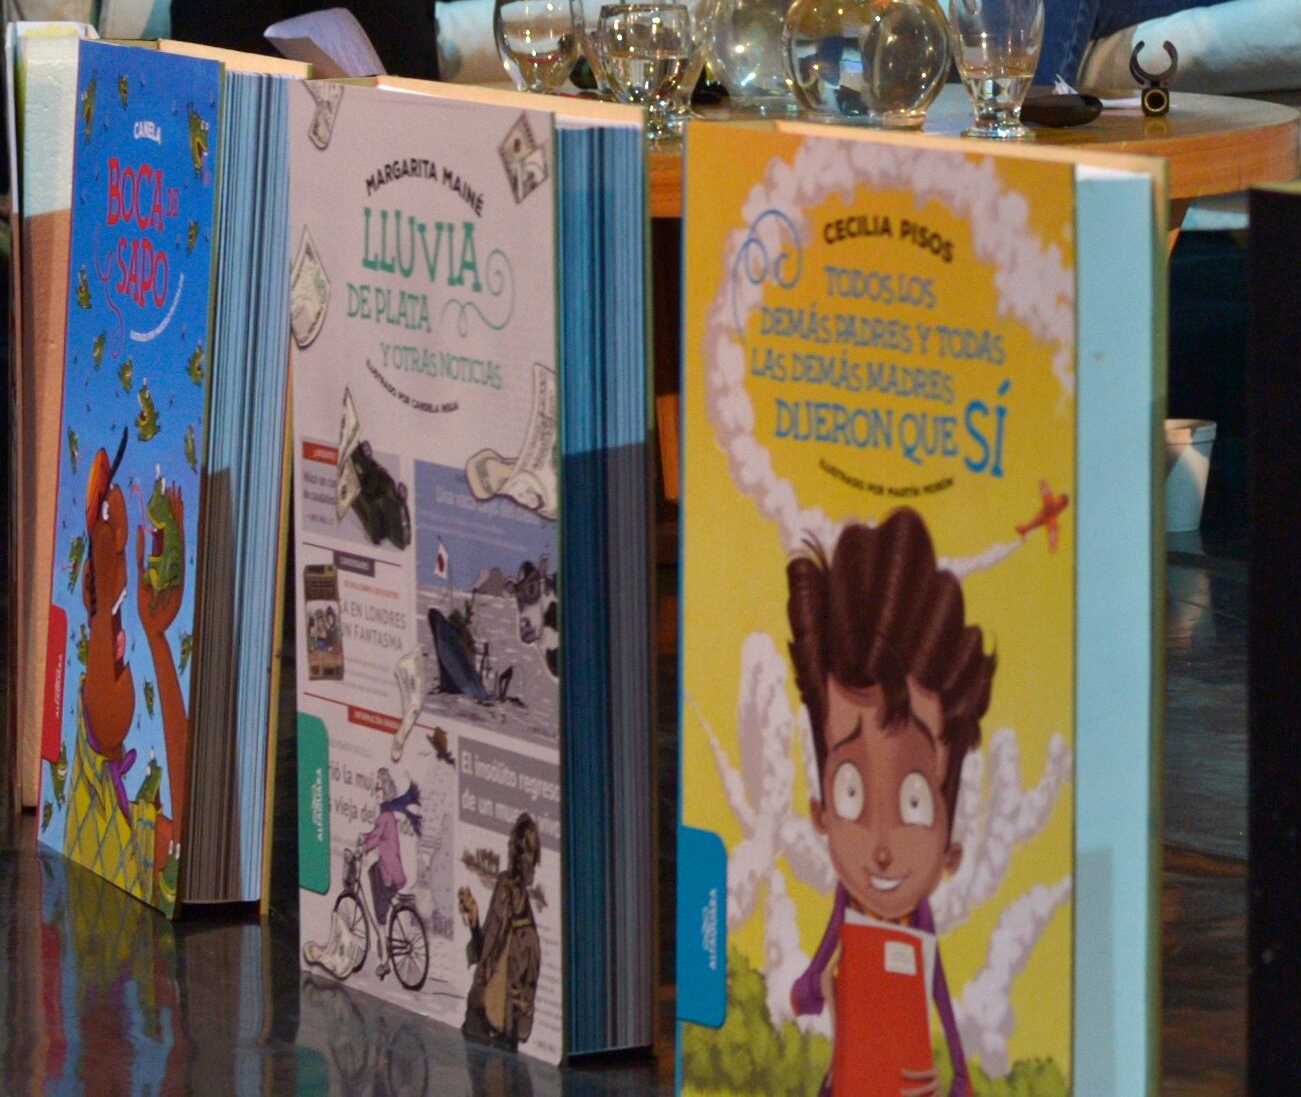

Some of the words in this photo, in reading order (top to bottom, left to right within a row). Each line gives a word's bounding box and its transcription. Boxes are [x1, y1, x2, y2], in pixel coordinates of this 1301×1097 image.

[107, 157, 165, 232] BOCA
[365, 158, 438, 197] MARGARITA
[442, 167, 484, 218] MAINÉ
[362, 206, 483, 293] LLUVIA
[823, 215, 892, 245] CECILIA
[900, 219, 954, 263] PISOS
[116, 236, 169, 308] SAPO
[825, 265, 893, 305] TODOS
[898, 273, 938, 310] LOS
[347, 283, 371, 319] DE
[374, 287, 432, 333] PLATA
[761, 302, 832, 344] DEMÁS
[835, 313, 914, 354] PADRES
[915, 323, 933, 355] Y
[936, 324, 1007, 366] TODAS
[380, 342, 391, 367] Y
[393, 345, 438, 378] OTRAS
[439, 353, 503, 389] NOTICIAS
[751, 347, 787, 382] LAS
[792, 349, 865, 392] DEMÁS
[866, 361, 956, 405] MADRES
[775, 398, 894, 450] DIJERON
[899, 412, 959, 466] QUE
[963, 378, 1012, 479] SÍ
